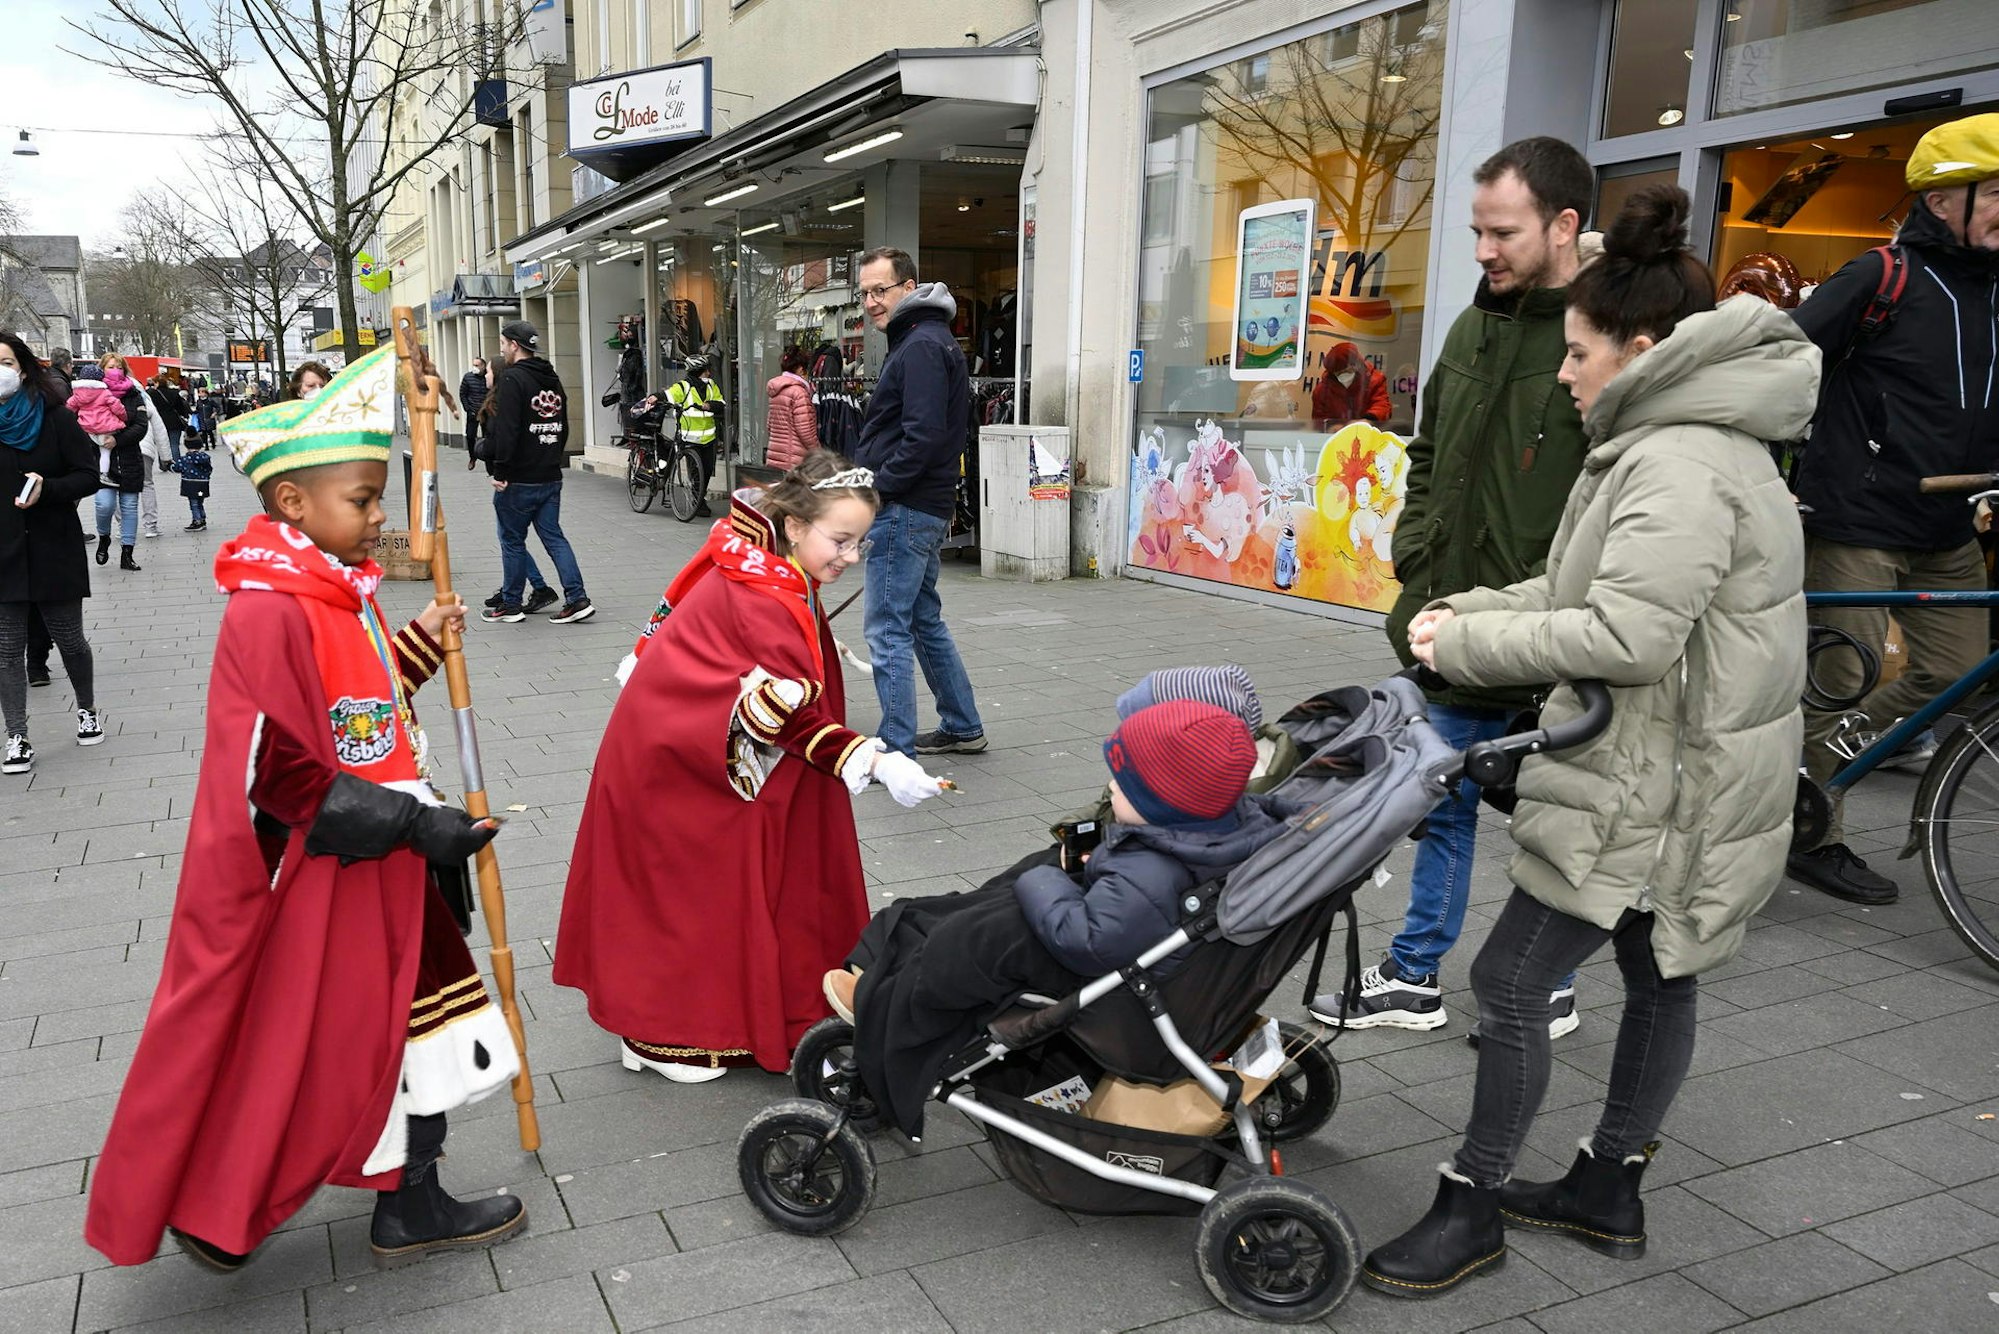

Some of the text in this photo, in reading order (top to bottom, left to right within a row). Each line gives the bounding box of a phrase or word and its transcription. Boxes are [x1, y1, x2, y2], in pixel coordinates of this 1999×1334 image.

[664, 79, 682, 98] bei
[621, 105, 659, 129] Mode
[664, 100, 686, 121] Elli
